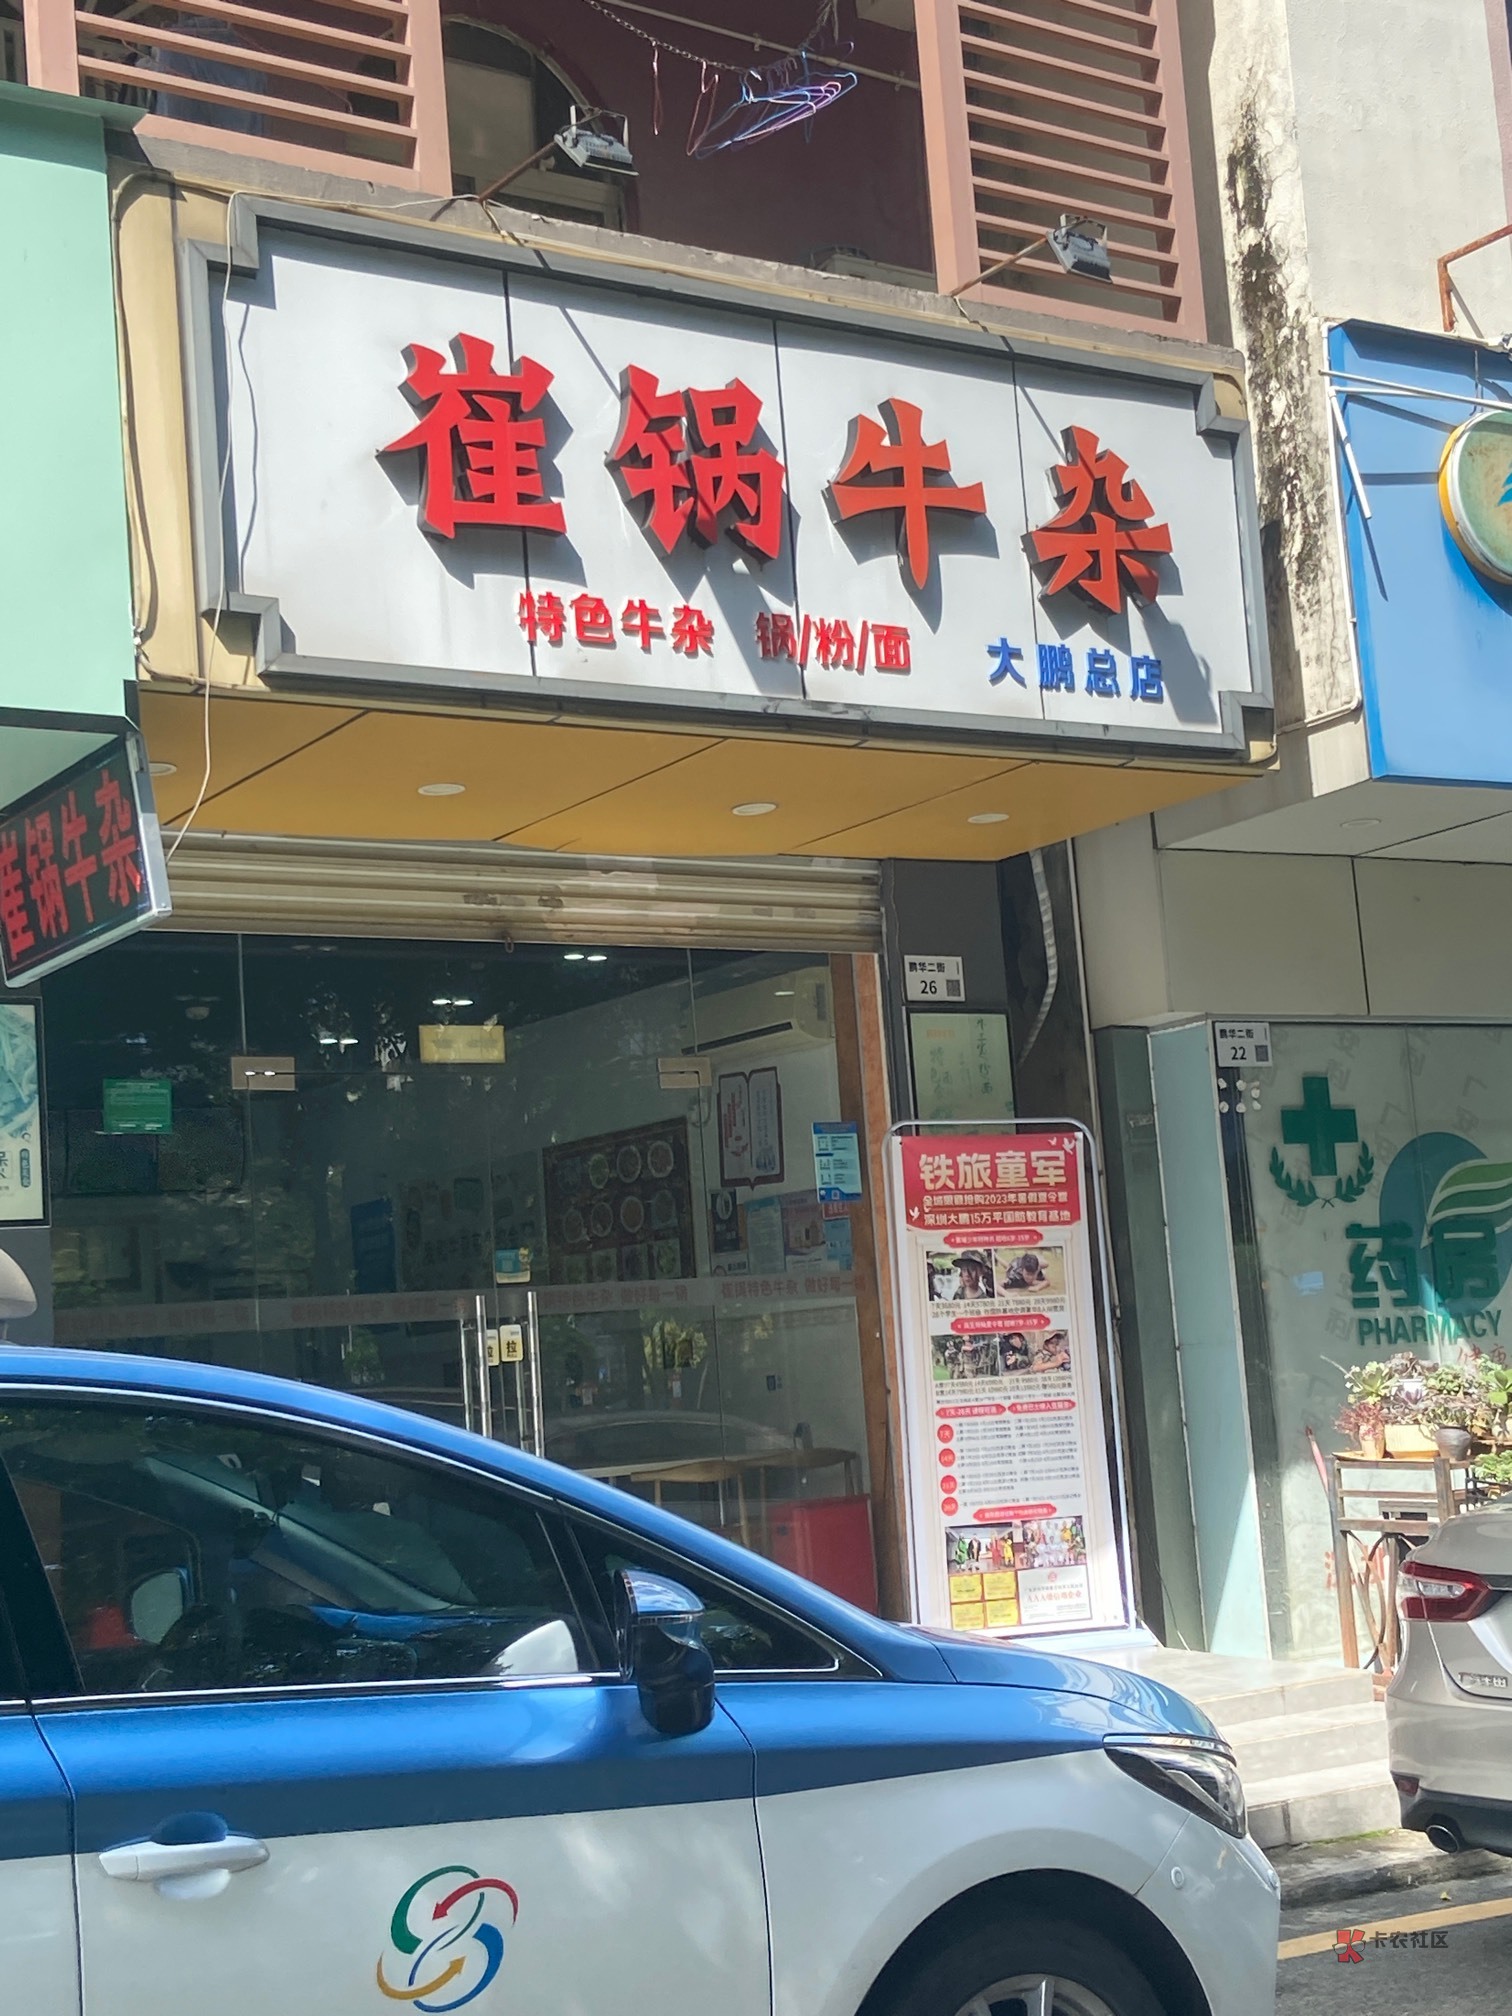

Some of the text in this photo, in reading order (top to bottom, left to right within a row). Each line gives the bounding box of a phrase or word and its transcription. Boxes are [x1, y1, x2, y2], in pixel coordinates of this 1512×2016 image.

[375, 332, 1174, 615] 崔锅牛杂
[519, 590, 911, 673] 特色牛杂 锅/粉/面
[988, 637, 1164, 702] 大鹏总店
[909, 961, 945, 973] 鹏华二街
[920, 980, 938, 995] 26
[1219, 1028, 1255, 1039] 鹏华二街
[1230, 1046, 1247, 1060] 22
[918, 1150, 1067, 1190] 铁旅童军
[1345, 1221, 1500, 1309] 药房
[506, 1340, 517, 1352] 拉
[1359, 1310, 1501, 1346] PHARMACY
